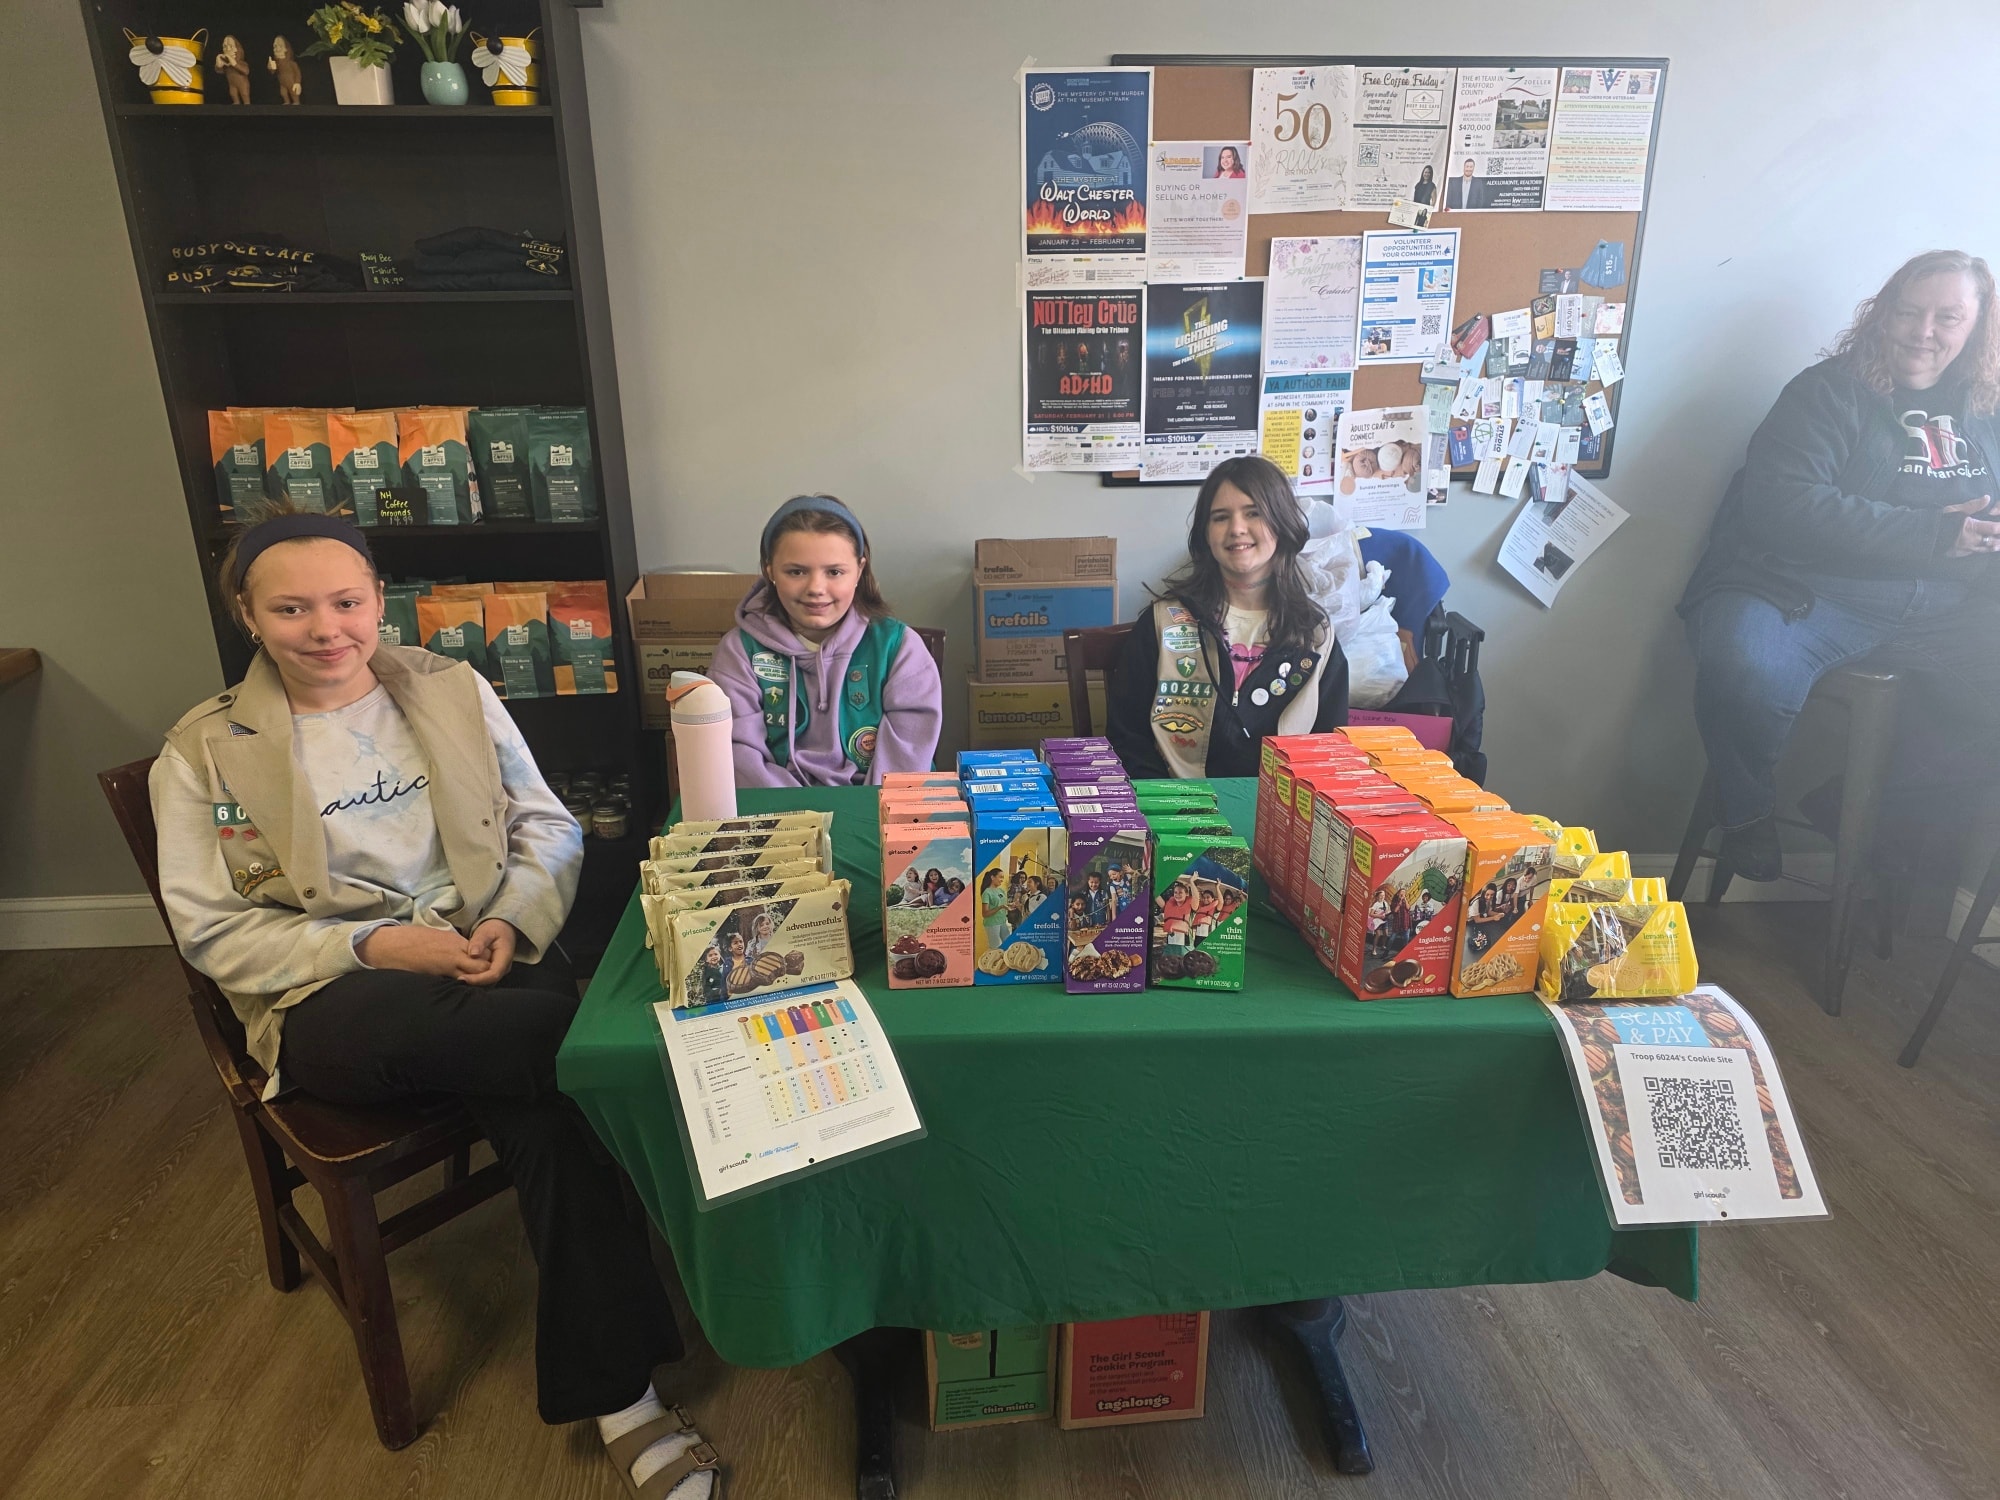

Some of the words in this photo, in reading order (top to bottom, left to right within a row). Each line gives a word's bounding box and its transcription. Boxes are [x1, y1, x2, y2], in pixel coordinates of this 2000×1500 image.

[1362, 72, 1381, 86] Free
[1384, 72, 1410, 87] Coffee
[1412, 73, 1439, 88] Friday
[1274, 92, 1332, 150] 50
[172, 243, 219, 258] BUSY
[379, 254, 392, 262] Bee
[168, 268, 213, 282] BUSY
[1194, 320, 1207, 328] THE
[1175, 319, 1228, 348] LIGHTNING
[1188, 336, 1216, 355] THIEF
[1270, 381, 1280, 390] YA
[1284, 378, 1322, 390] AUTHOR
[1326, 377, 1347, 388] FAIR
[1351, 423, 1370, 432] ADULTS
[1372, 422, 1389, 430] CRAFT
[1350, 432, 1375, 441] CONNECT
[380, 491, 391, 499] NH
[386, 500, 408, 509] Coffee
[988, 611, 1049, 628] trefoils
[1161, 682, 1211, 696] 60244
[978, 710, 1060, 725] lemon-ups
[786, 917, 842, 932] adventurefuls
[682, 928, 692, 938] girl
[692, 926, 712, 935] scouts
[1419, 936, 1450, 944] tagalongs
[1620, 1011, 1683, 1027] SCAN
[1630, 1029, 1645, 1044] &
[1652, 1027, 1694, 1043] PAY
[1630, 1053, 1654, 1061] Troop
[1656, 1053, 1686, 1062] 60244's
[1687, 1054, 1715, 1062] Cookie
[729, 1159, 748, 1168] scouts
[1090, 1354, 1109, 1363] The
[1111, 1352, 1133, 1362] Girl
[1135, 1350, 1165, 1360] Scout
[1090, 1362, 1126, 1373] Cookie
[1128, 1359, 1177, 1371] Program.
[983, 1405, 1004, 1415] thin
[1005, 1402, 1036, 1412] mints
[1097, 1394, 1172, 1411] tagalongs
